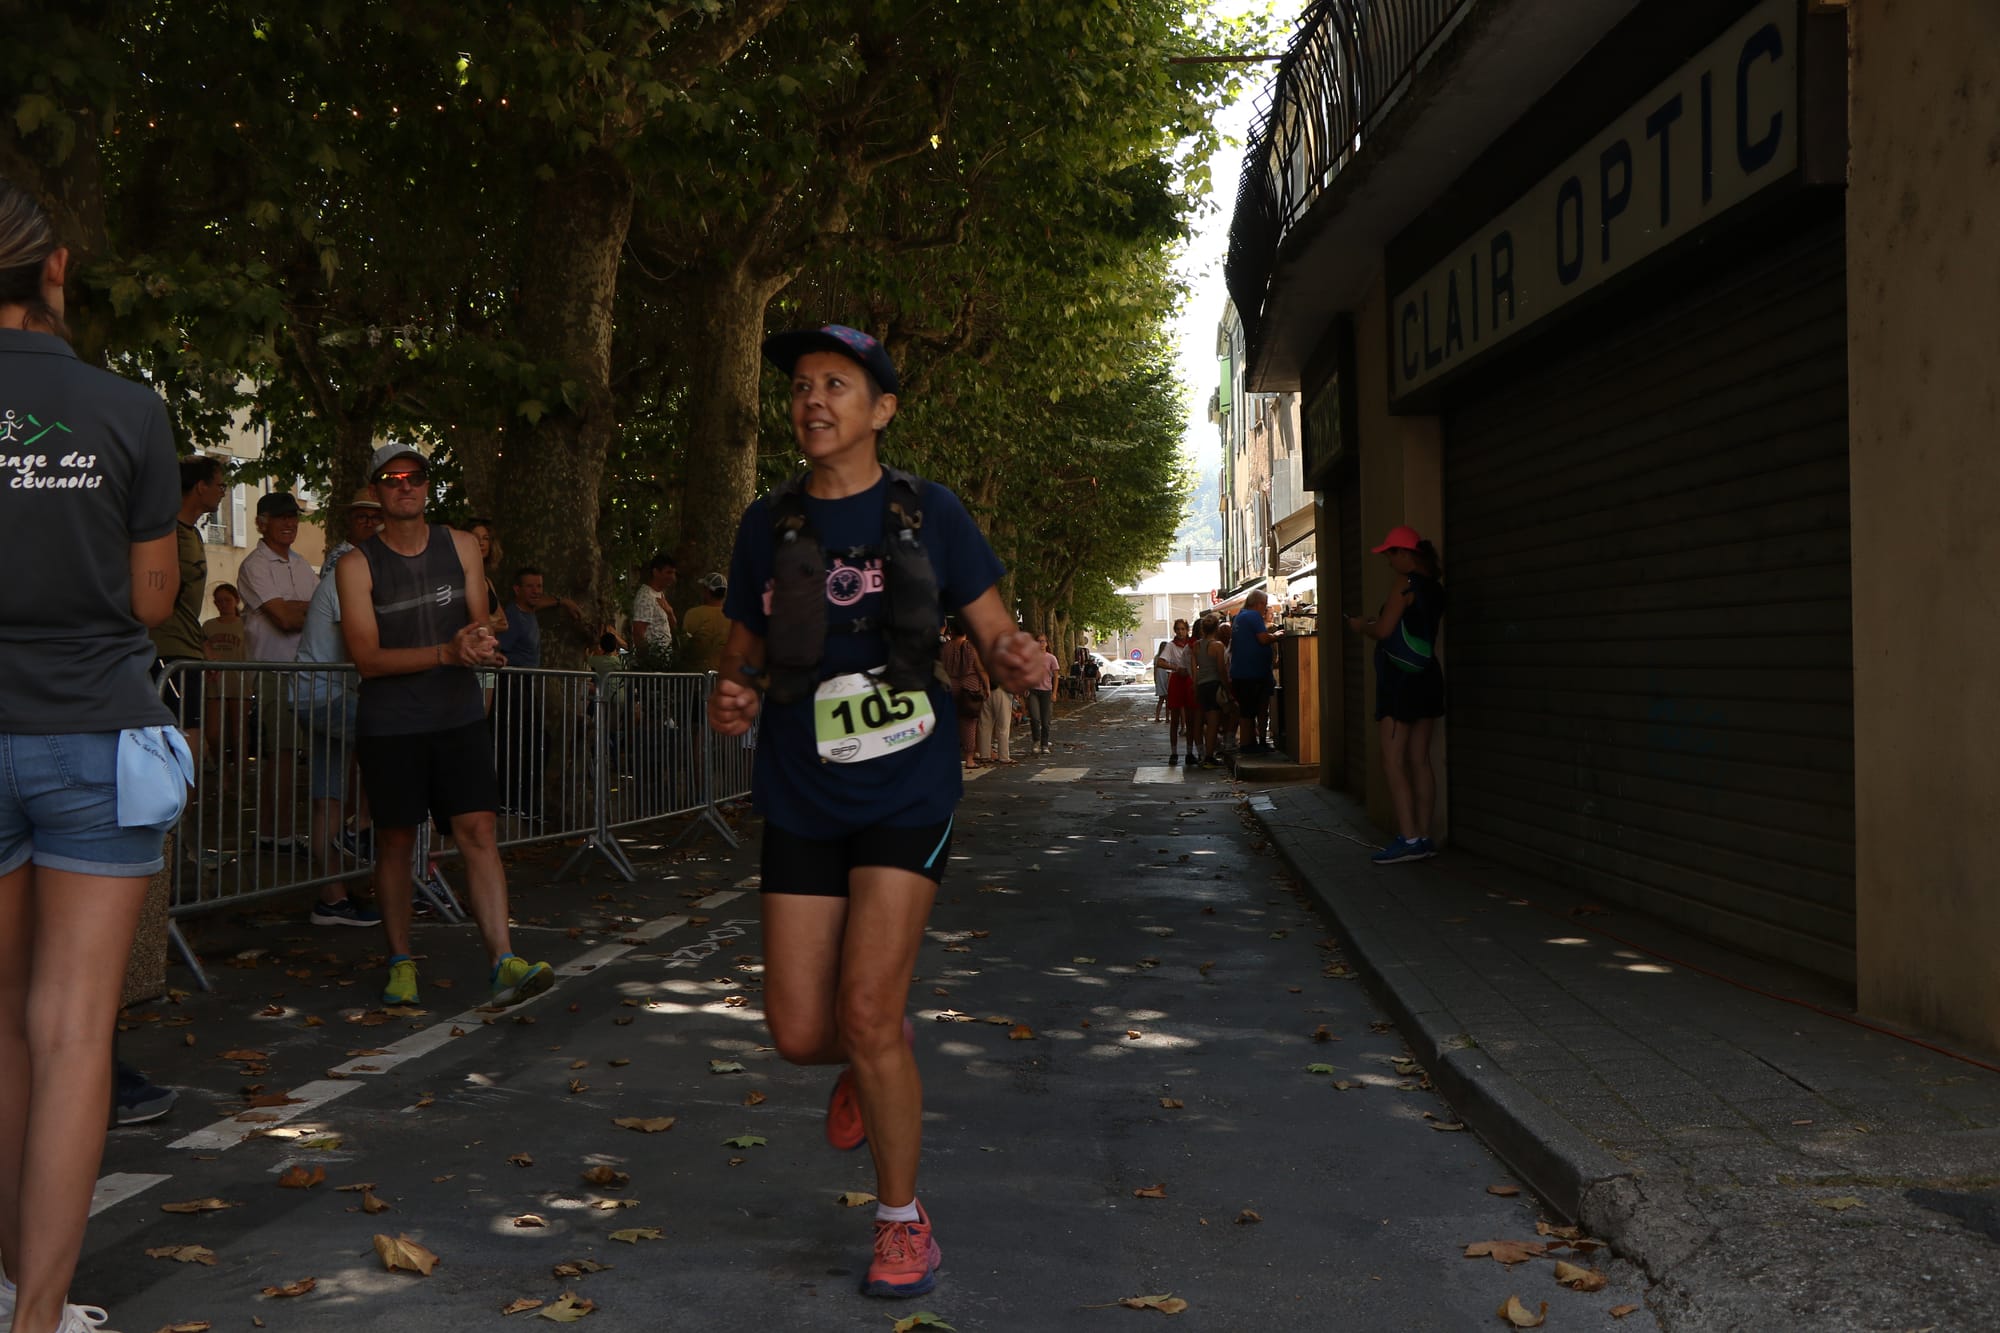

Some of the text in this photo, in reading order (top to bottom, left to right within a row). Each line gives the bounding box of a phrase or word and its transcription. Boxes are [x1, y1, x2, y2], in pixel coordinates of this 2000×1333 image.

[1401, 23, 1784, 381] CLAIR OPTIC
[59, 451, 97, 468] des
[10, 470, 103, 489] cévenoles
[831, 688, 915, 735] 105
